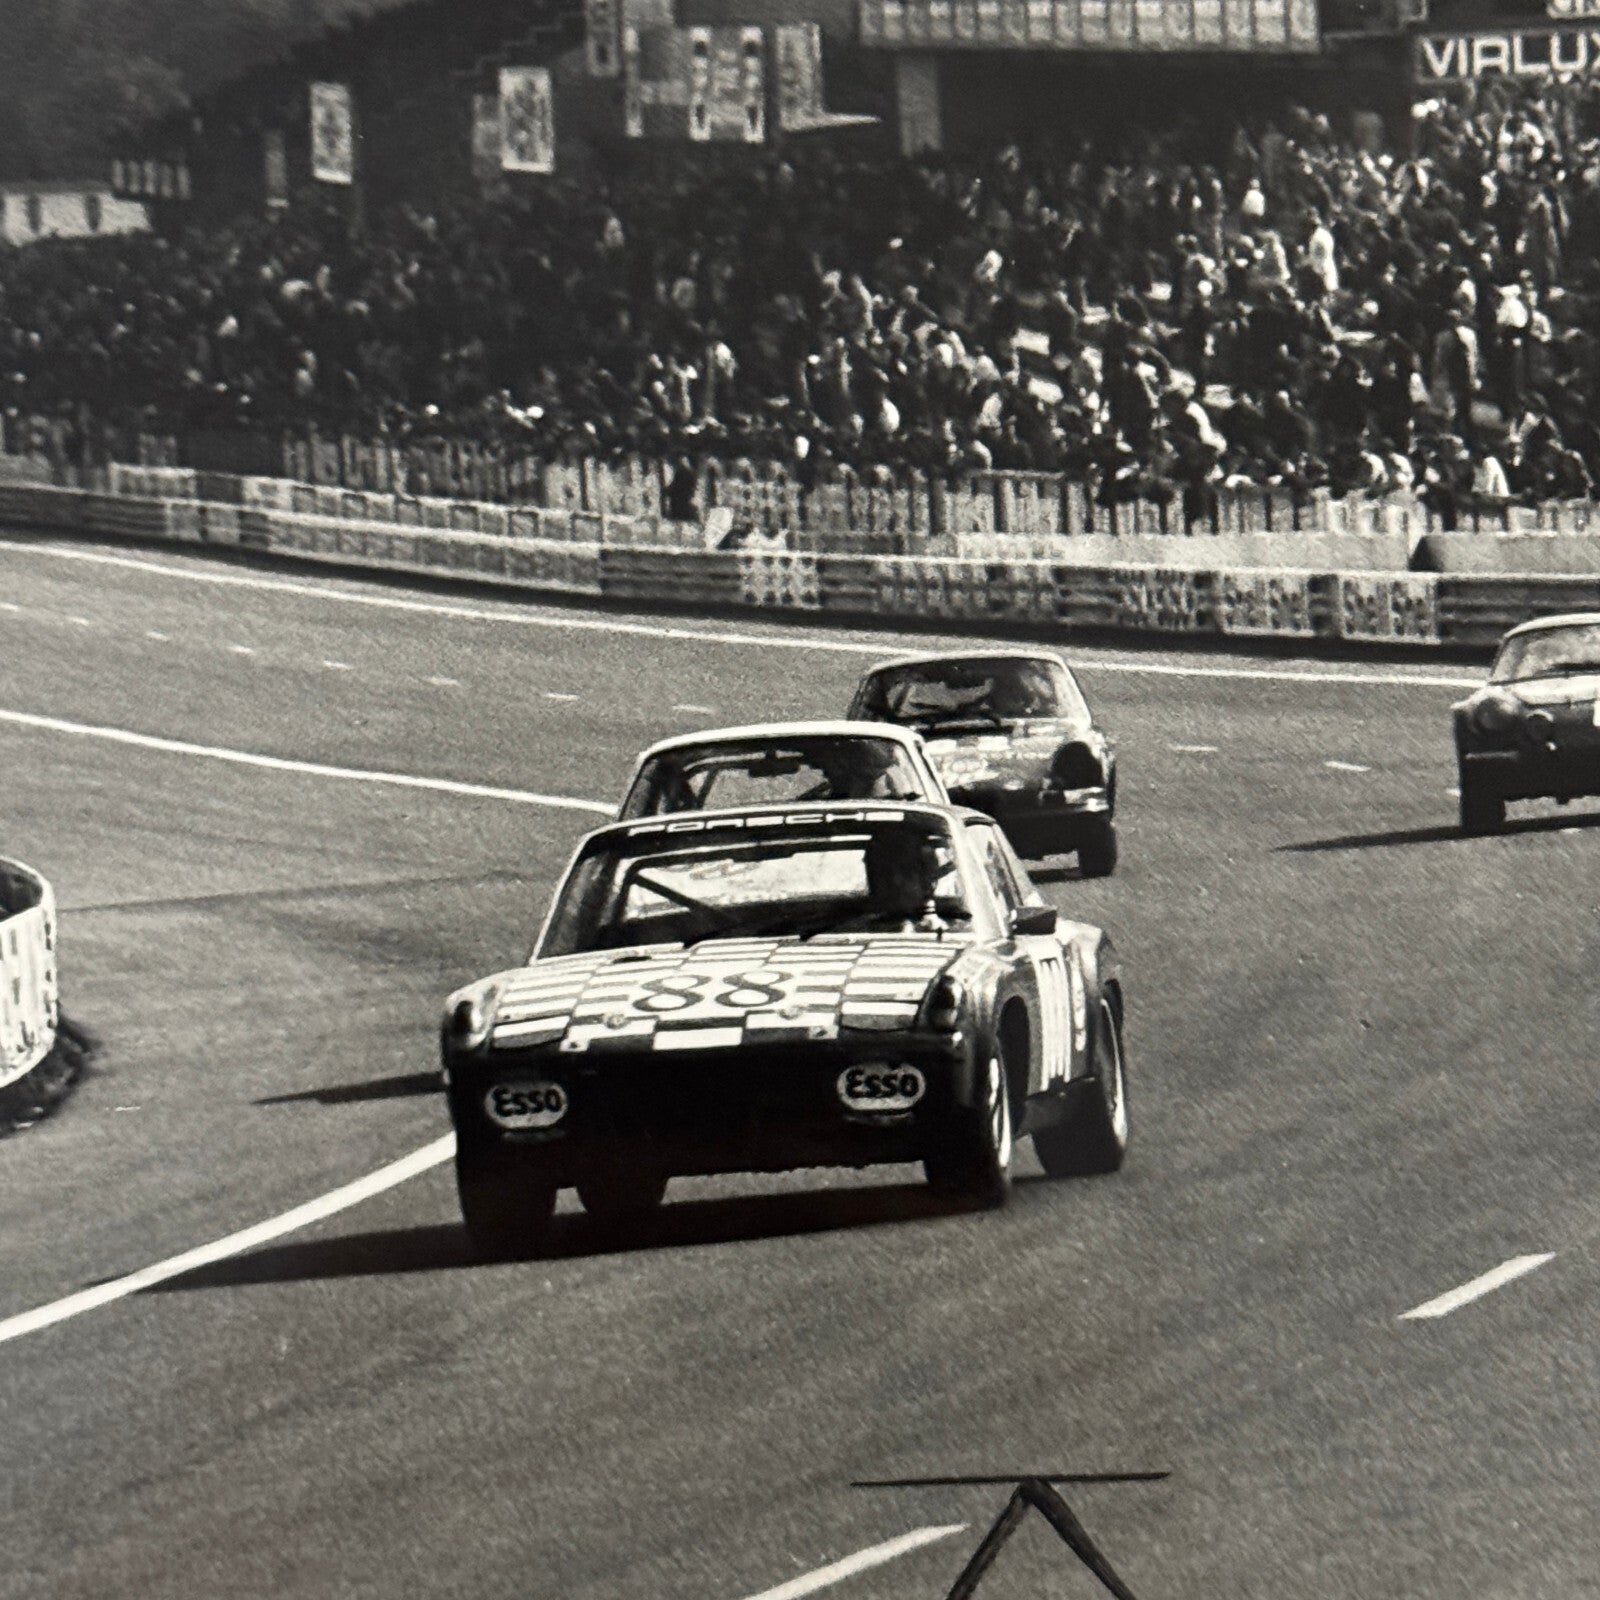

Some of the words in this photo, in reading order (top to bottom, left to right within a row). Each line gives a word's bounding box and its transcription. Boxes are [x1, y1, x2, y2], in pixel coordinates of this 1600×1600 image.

[628, 811, 905, 837] PORSCHE
[632, 970, 794, 1012] 88
[845, 1069, 920, 1098] Esso
[492, 1088, 563, 1118] Esso
